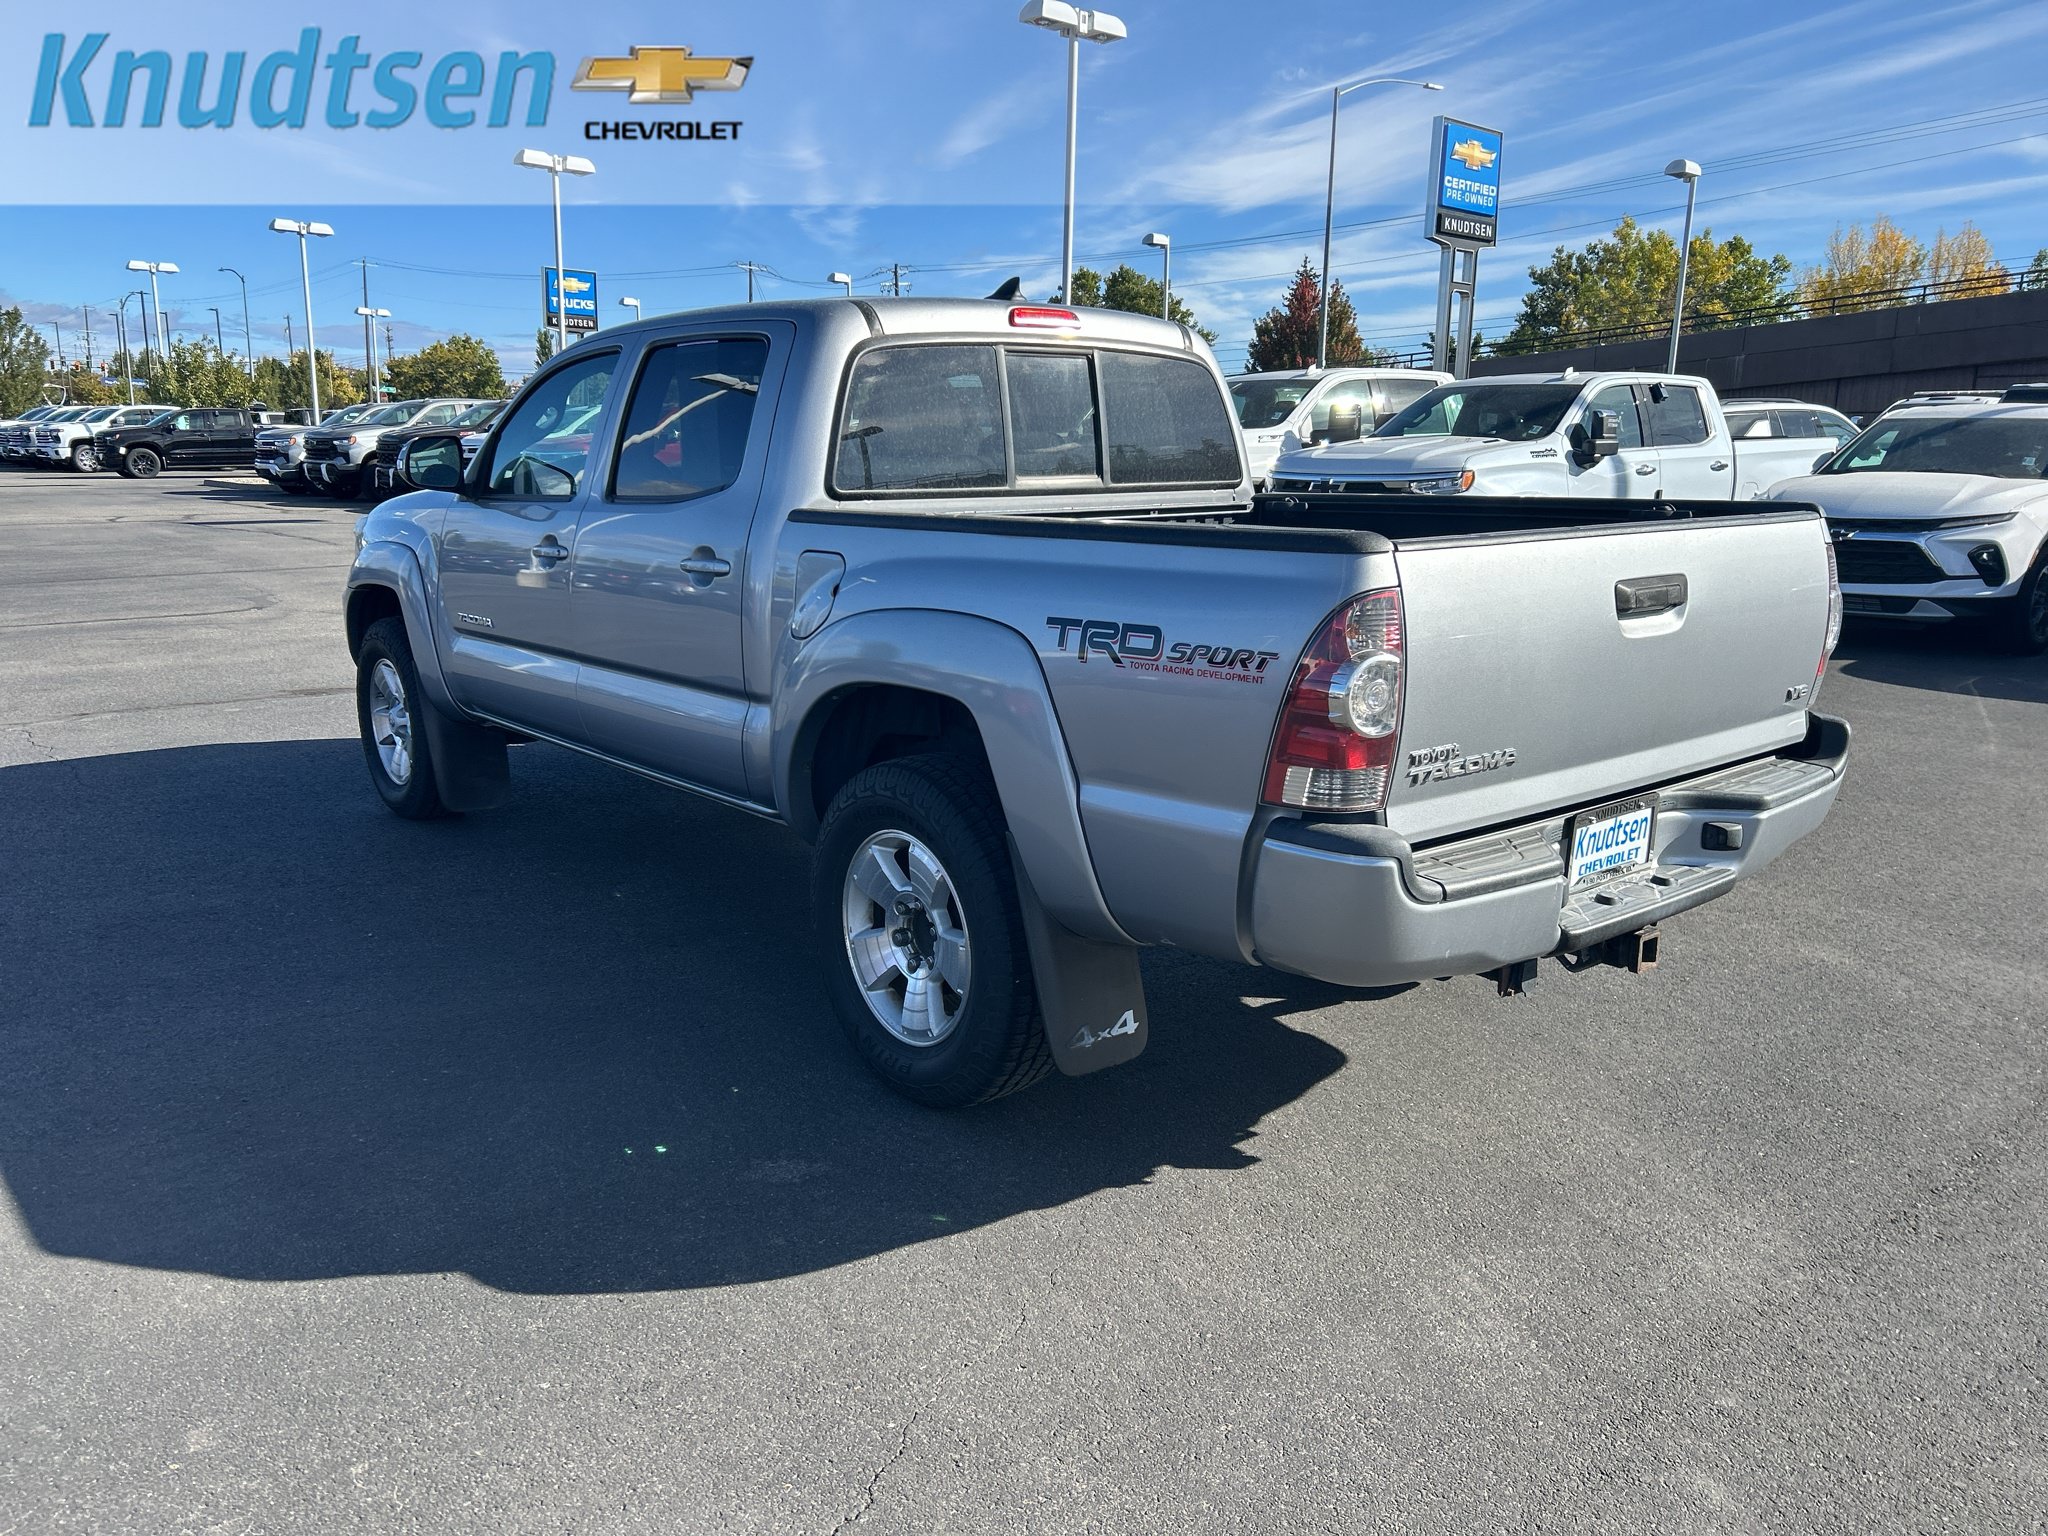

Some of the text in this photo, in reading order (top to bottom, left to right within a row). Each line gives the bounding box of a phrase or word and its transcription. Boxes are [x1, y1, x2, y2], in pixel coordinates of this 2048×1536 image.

[1444, 175, 1497, 196] CERTIFIED
[1446, 190, 1494, 207] PRE-OWNED
[1444, 217, 1493, 237] KNUDTSEN
[551, 296, 594, 310] TUCKS
[552, 317, 594, 328] KUDTSEN
[1046, 616, 1280, 673] TRD SPORT
[1130, 660, 1265, 685] TOYOTA RACING DEVELOPMENT
[1404, 747, 1517, 788] TACOMA
[1408, 743, 1460, 769] TOYOTA
[1575, 816, 1649, 860] Knudtsen
[1578, 846, 1641, 876] CHEVROLET
